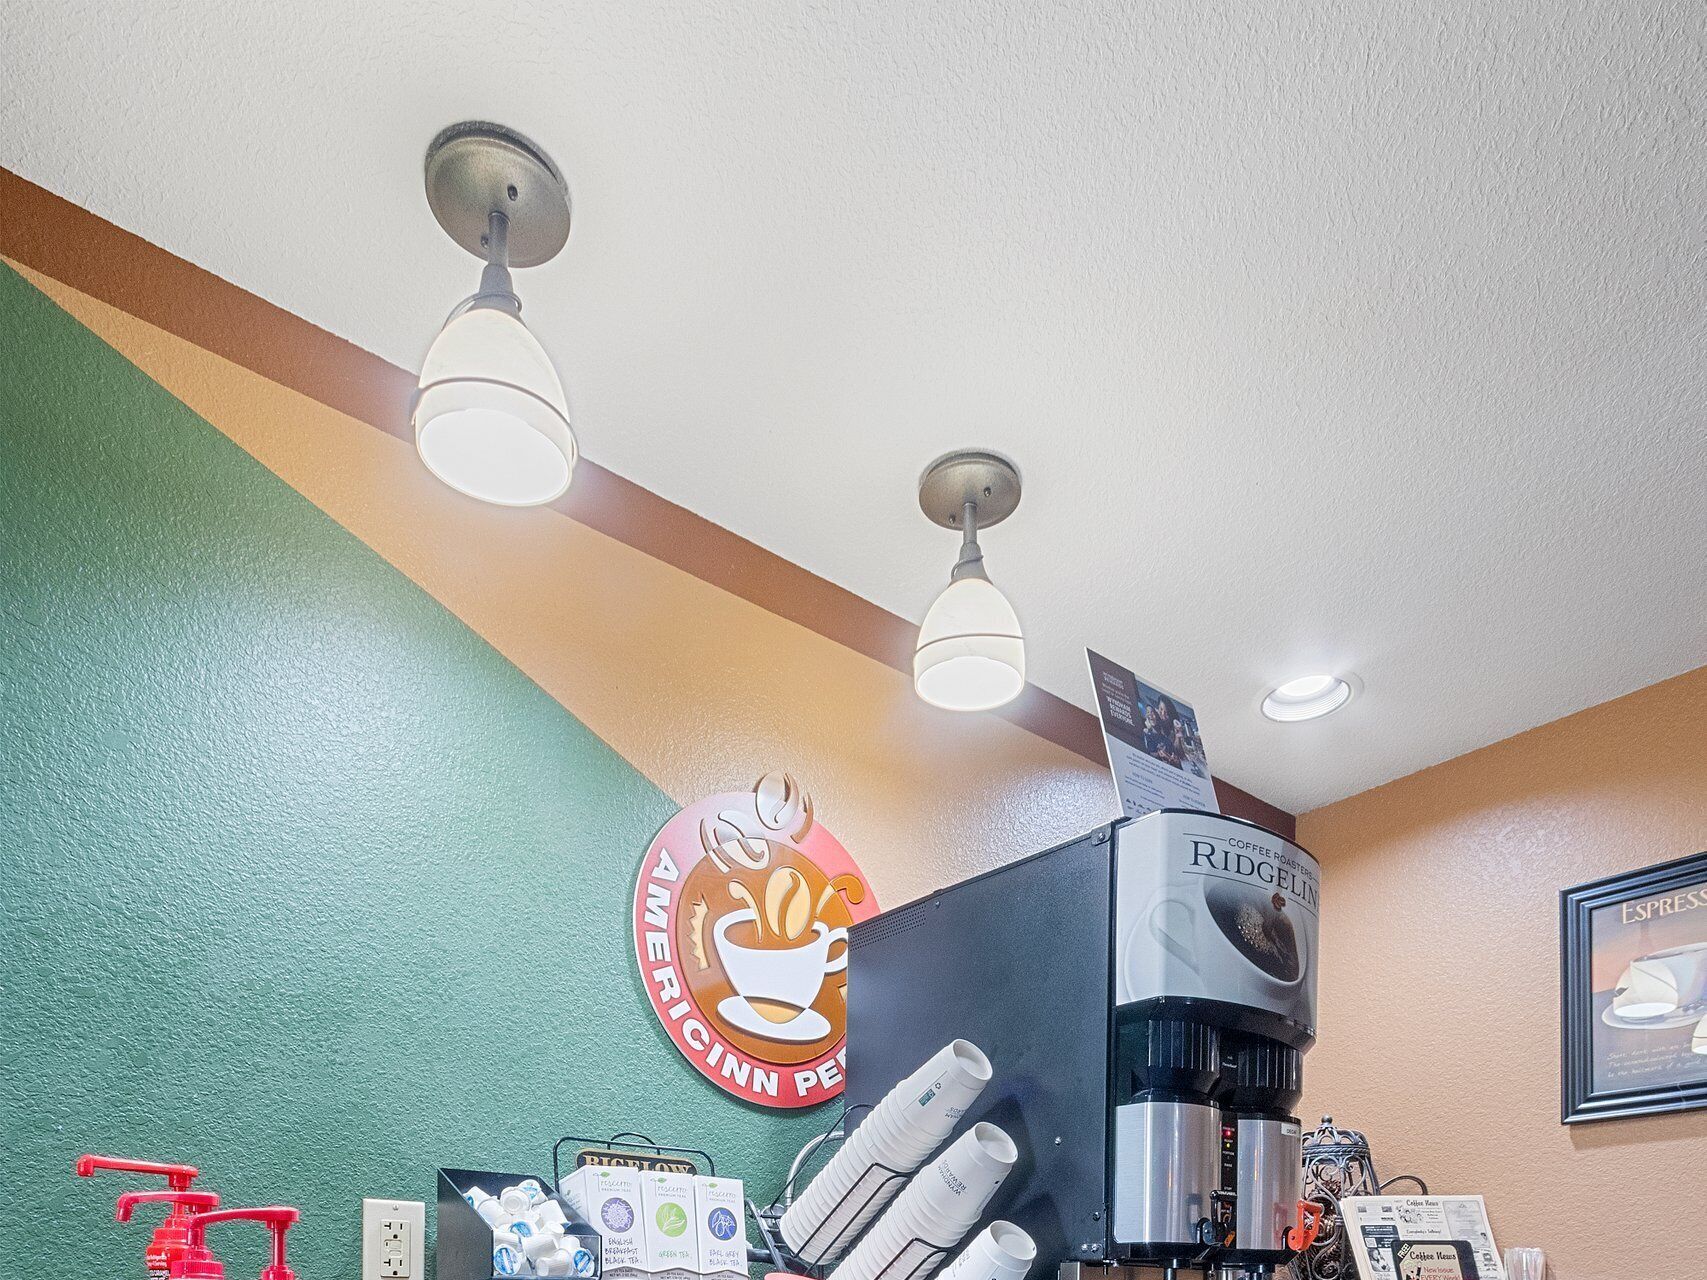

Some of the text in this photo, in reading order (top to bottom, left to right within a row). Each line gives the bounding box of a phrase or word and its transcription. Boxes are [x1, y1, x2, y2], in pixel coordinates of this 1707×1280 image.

[1107, 696, 1131, 713] WYNDHAM
[1110, 703, 1132, 718] REWARDS
[1228, 838, 1312, 880] COFFEE ROASTERS
[1189, 840, 1318, 909] RIDGELIN
[644, 848, 847, 1097] AMERICINN PE
[608, 1238, 633, 1246] ENGLISH
[1397, 1243, 1410, 1258] FREE
[1410, 1251, 1456, 1261] Coffee News
[605, 1256, 626, 1265] BLACK
